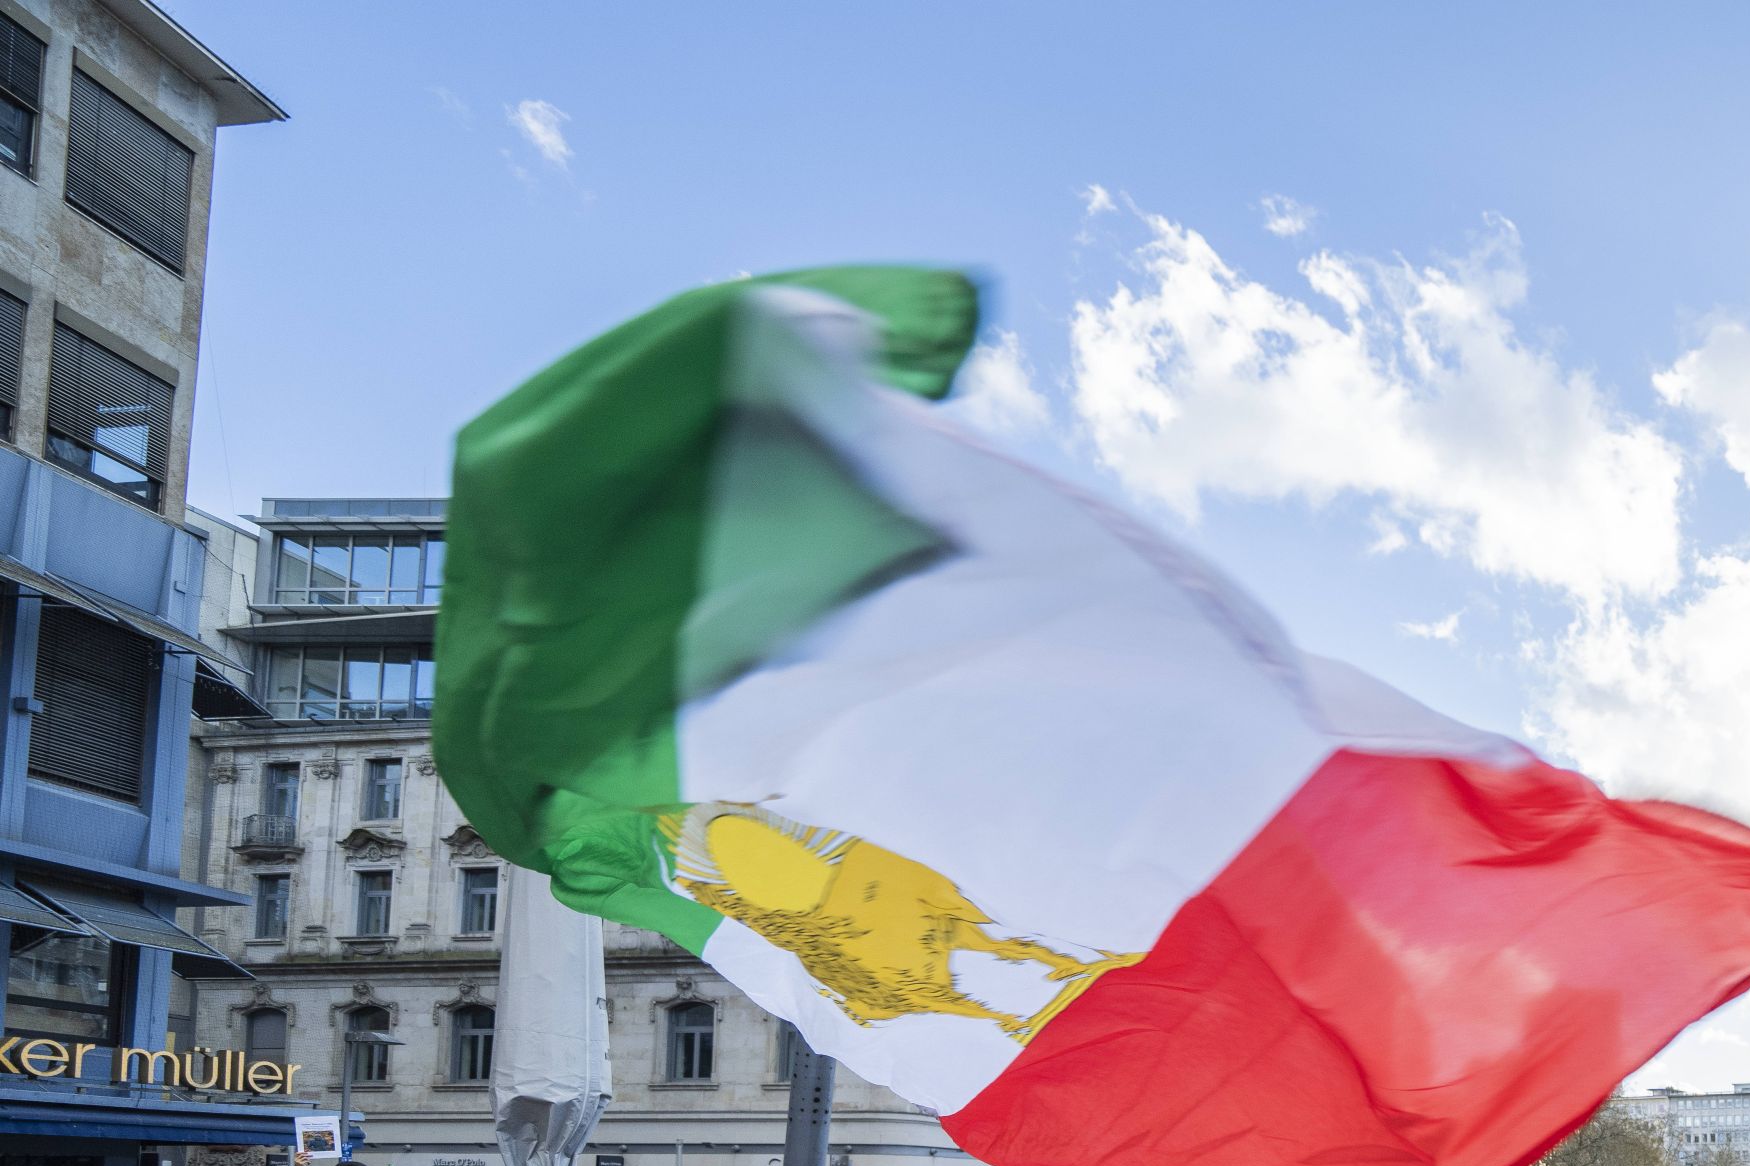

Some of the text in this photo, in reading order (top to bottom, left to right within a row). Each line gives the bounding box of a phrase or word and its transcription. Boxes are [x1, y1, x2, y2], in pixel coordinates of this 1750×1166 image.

[115, 1046, 301, 1095] müller
[432, 1158, 486, 1166] Marc O'Polo
